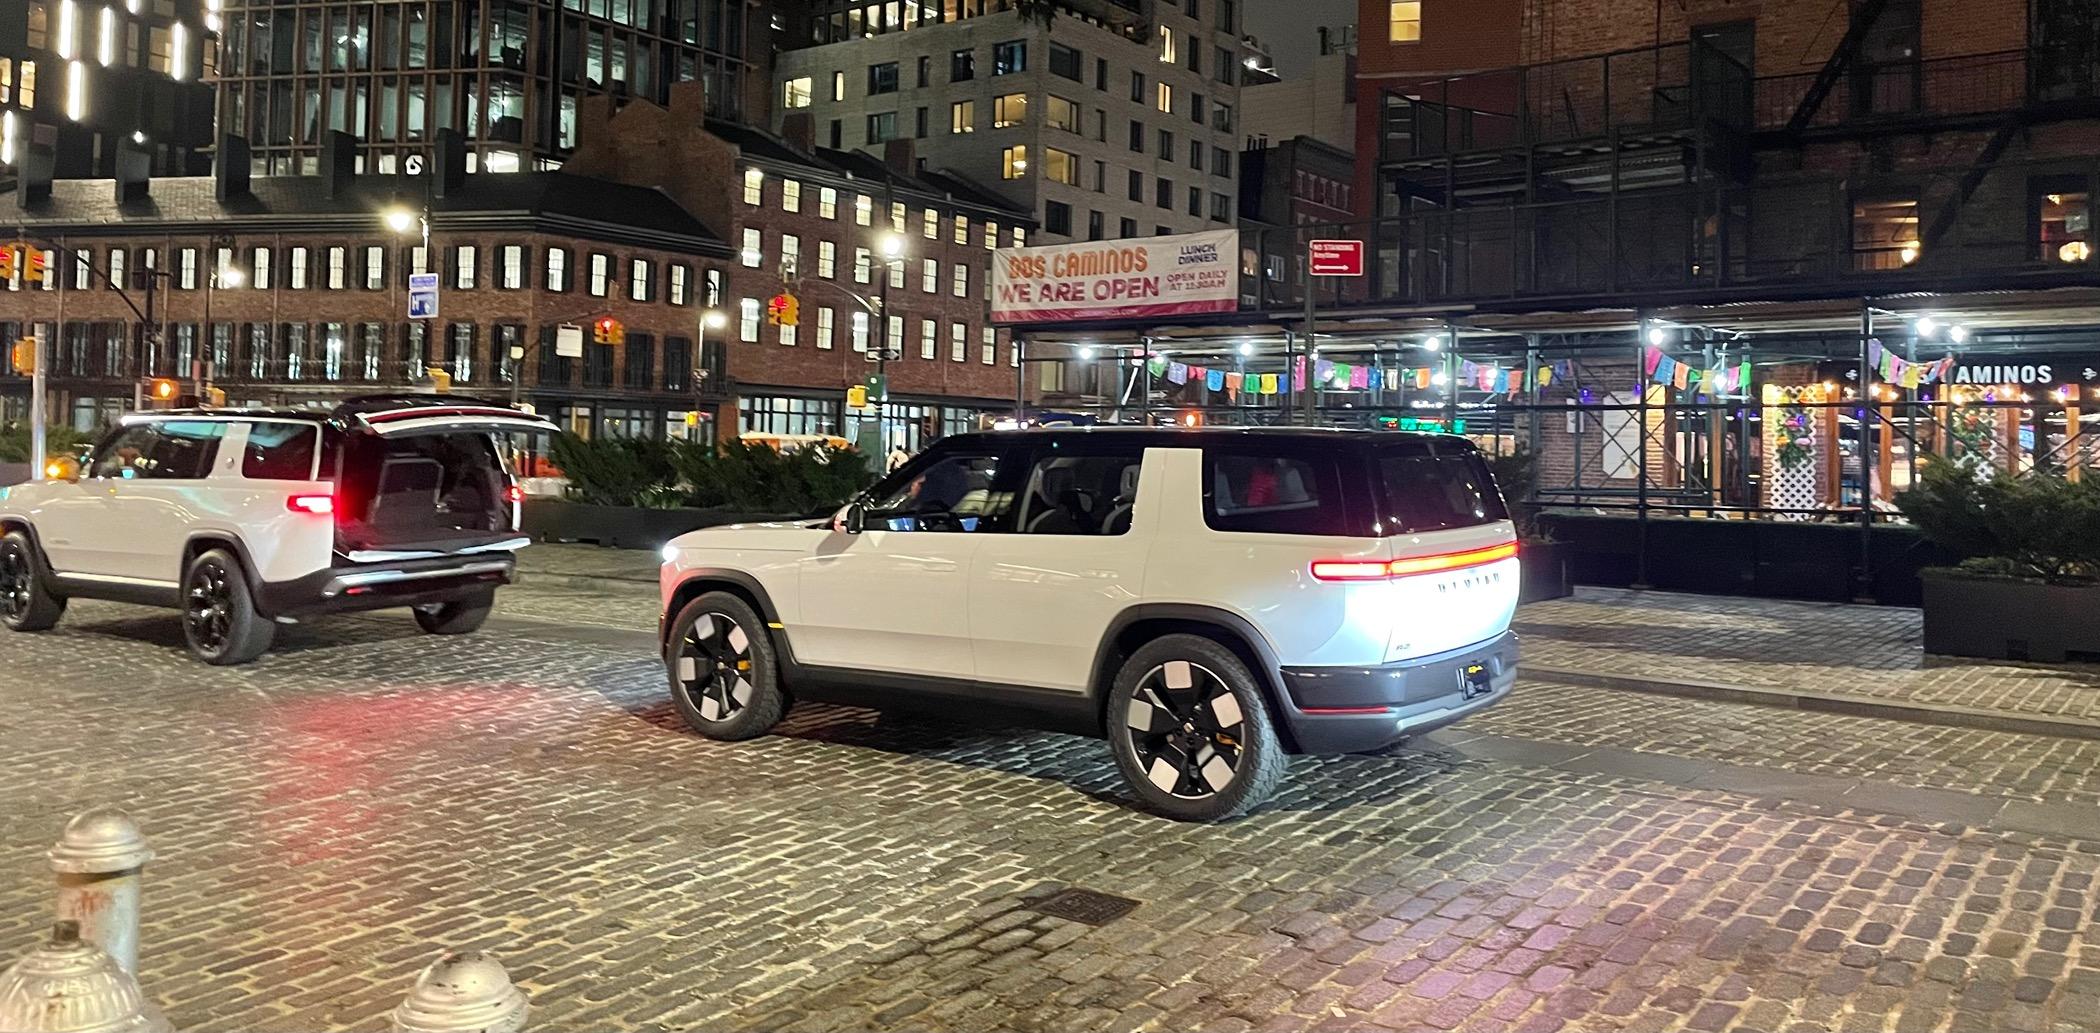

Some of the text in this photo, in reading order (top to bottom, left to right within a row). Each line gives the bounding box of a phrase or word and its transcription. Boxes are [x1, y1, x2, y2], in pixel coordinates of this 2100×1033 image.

[1181, 243, 1216, 255] LUNCH
[1009, 246, 1148, 279] DOS CAMINOS
[1178, 253, 1218, 265] DINNER
[1167, 270, 1228, 283] OPEN DAILY
[998, 276, 1160, 303] WE ARE OPEN
[1169, 282, 1183, 291] AT
[1940, 364, 2053, 385] AMINOS
